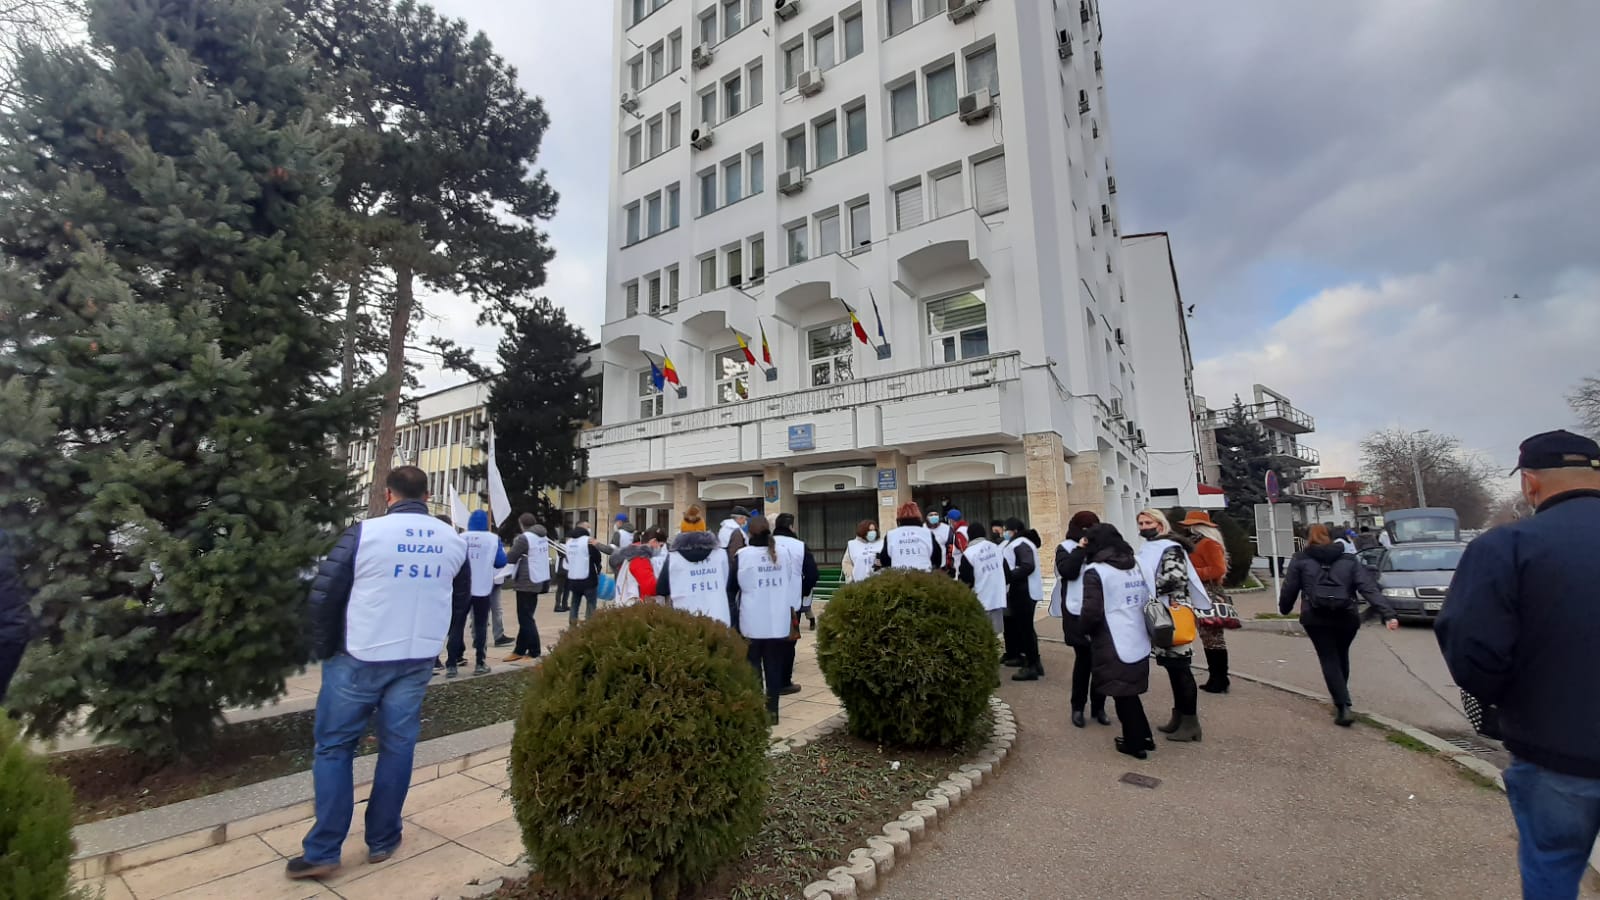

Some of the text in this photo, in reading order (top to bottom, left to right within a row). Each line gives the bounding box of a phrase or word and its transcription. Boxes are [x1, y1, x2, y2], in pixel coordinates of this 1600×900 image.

[406, 528, 435, 537] SIP
[397, 543, 443, 554] BUZAU
[899, 547, 921, 556] FSLI
[393, 564, 441, 578] FSLI
[690, 567, 718, 577] BUZAU
[757, 565, 783, 573] BUZAU
[691, 580, 719, 593] FSLI
[758, 577, 784, 588] FSLI
